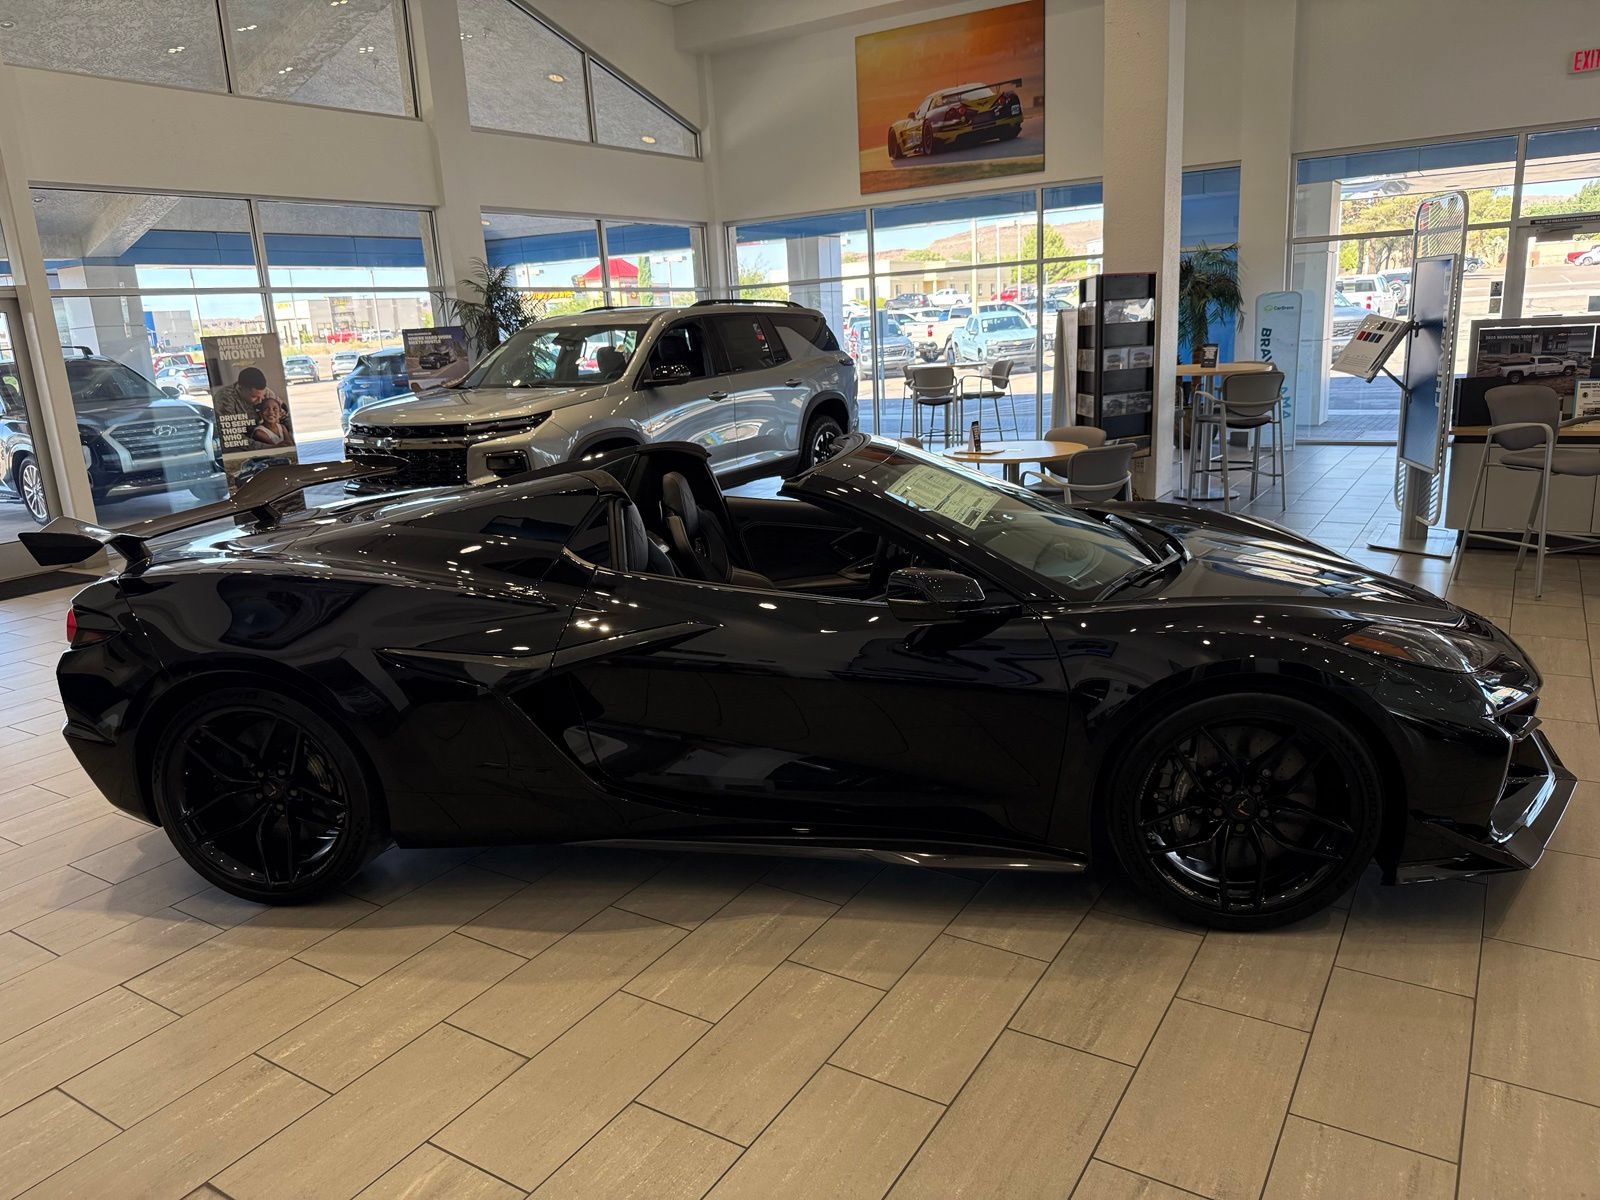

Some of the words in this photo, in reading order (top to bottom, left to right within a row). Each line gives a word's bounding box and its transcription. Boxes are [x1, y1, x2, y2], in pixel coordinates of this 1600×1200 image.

[1574, 49, 1600, 70] EXIT
[217, 336, 262, 346] MILITARY
[218, 343, 263, 352] APPRECIATION
[219, 349, 265, 361] MONTH
[219, 413, 248, 422] DRIVEN
[231, 419, 256, 427] SERVE
[222, 426, 247, 435] THOSE
[222, 434, 242, 442] WHO
[224, 439, 249, 448] SERVE
